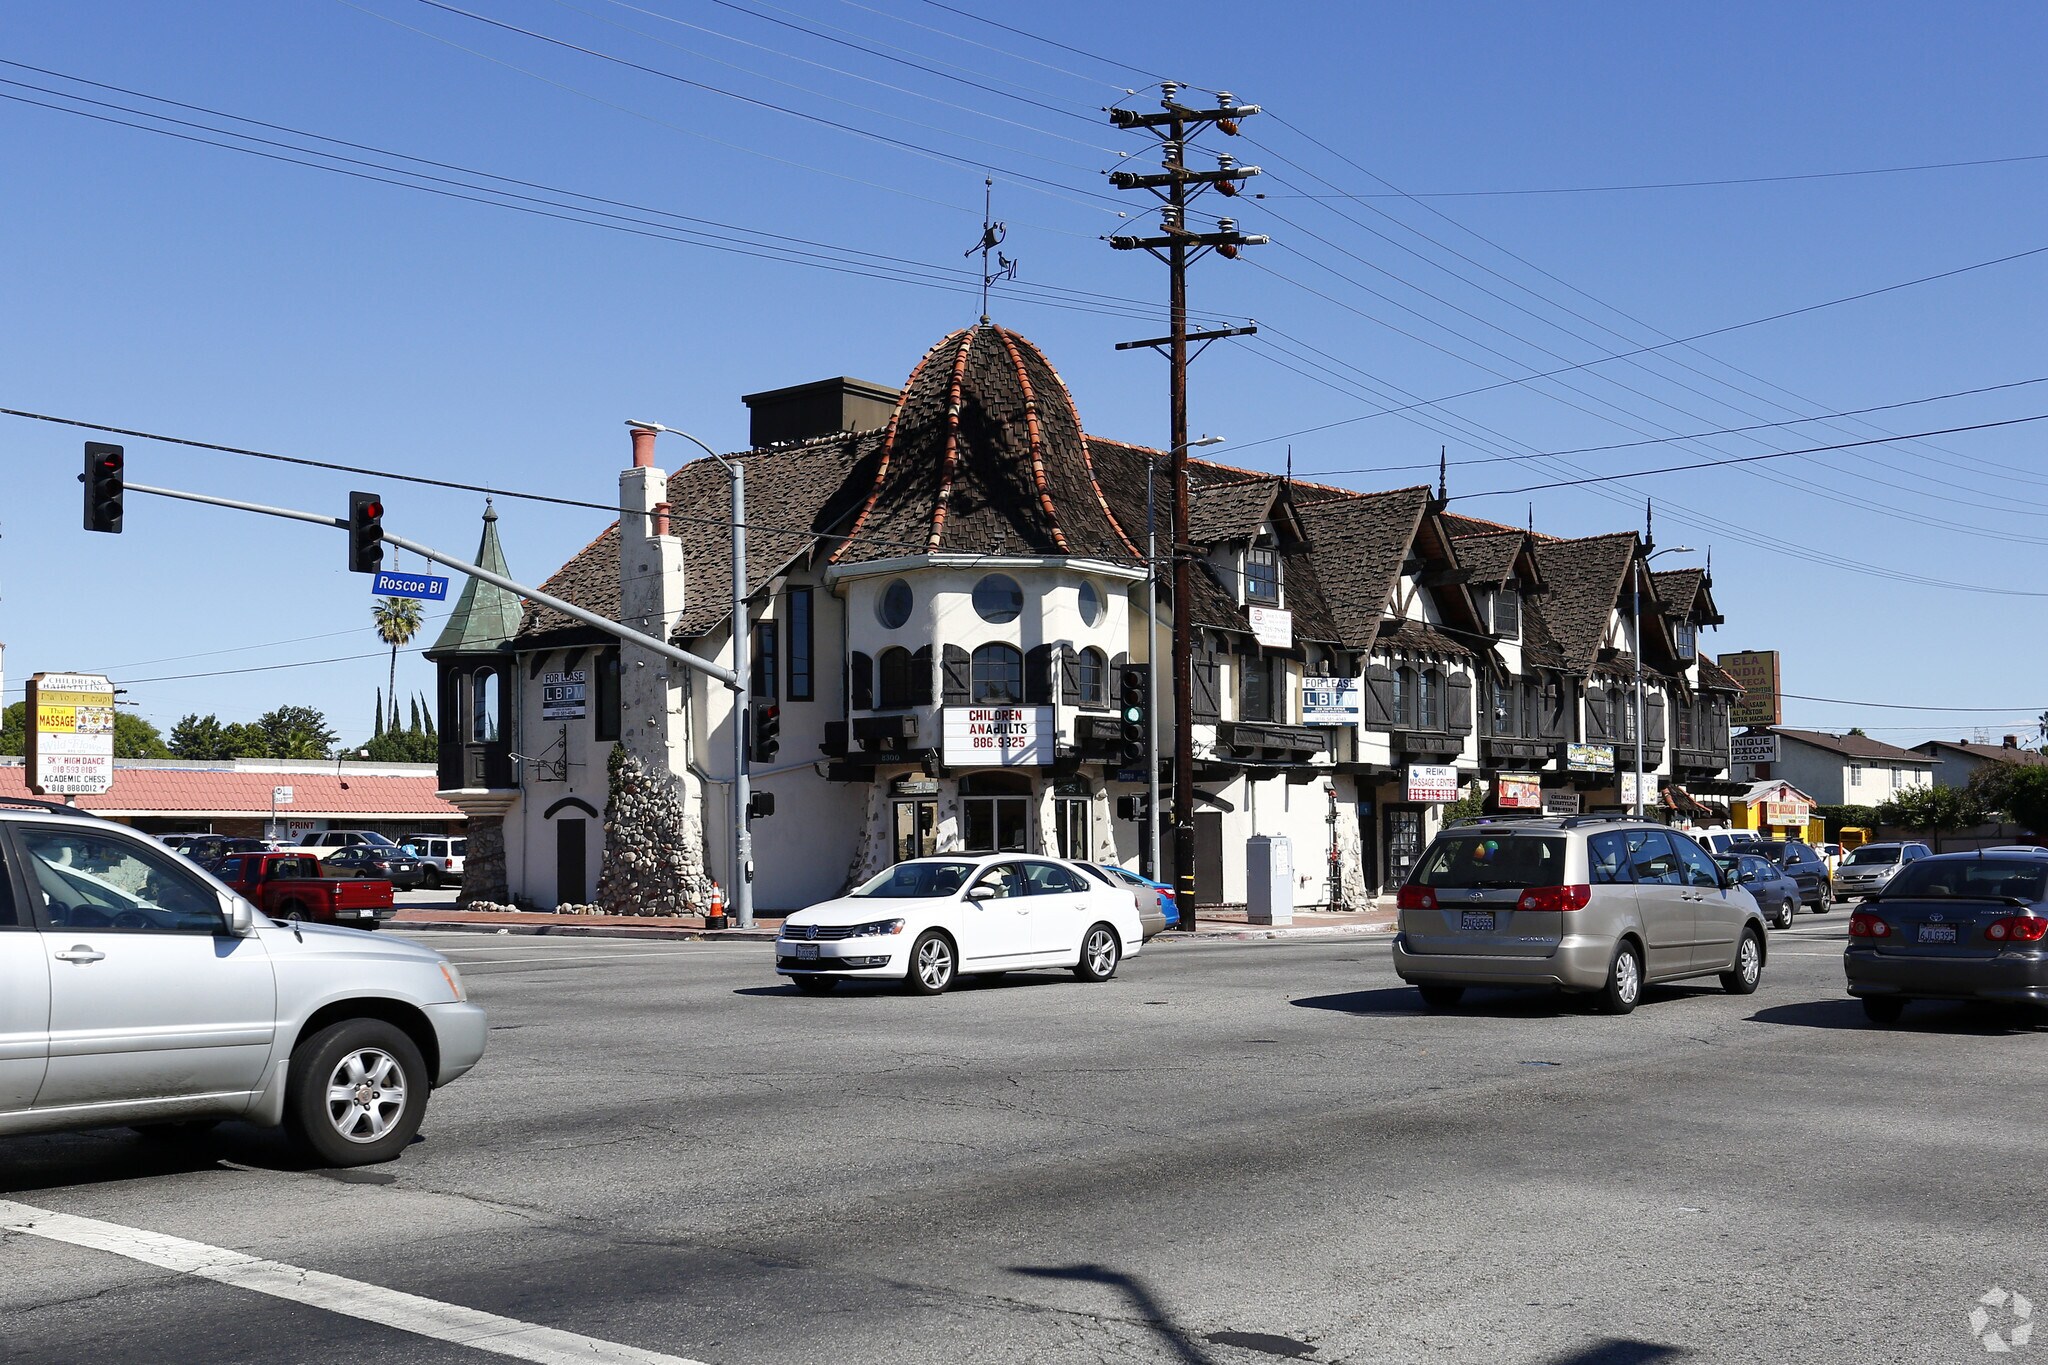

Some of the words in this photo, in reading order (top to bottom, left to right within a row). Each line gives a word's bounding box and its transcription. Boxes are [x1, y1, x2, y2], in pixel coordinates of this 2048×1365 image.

[379, 575, 425, 592] Roscoe
[429, 581, 443, 594] Bl
[48, 677, 102, 685] CHILDRENS
[545, 673, 559, 683] FOR
[1305, 679, 1323, 687] FOR
[1326, 679, 1355, 688] LEASE
[969, 709, 1022, 721] CHILDREN
[39, 715, 75, 727] MASSAGE
[973, 737, 1025, 748] 886.9325
[64, 757, 81, 765] HIGH
[82, 757, 105, 765] DANCE
[1426, 767, 1447, 776] REIKI
[44, 775, 82, 783] ACADEMIC
[84, 775, 106, 783] CHESS
[1410, 778, 1435, 786] MASSAGE
[1437, 778, 1456, 787] CENTER
[51, 784, 65, 792] 818
[289, 821, 314, 829] PRINT
[291, 830, 298, 838] &
